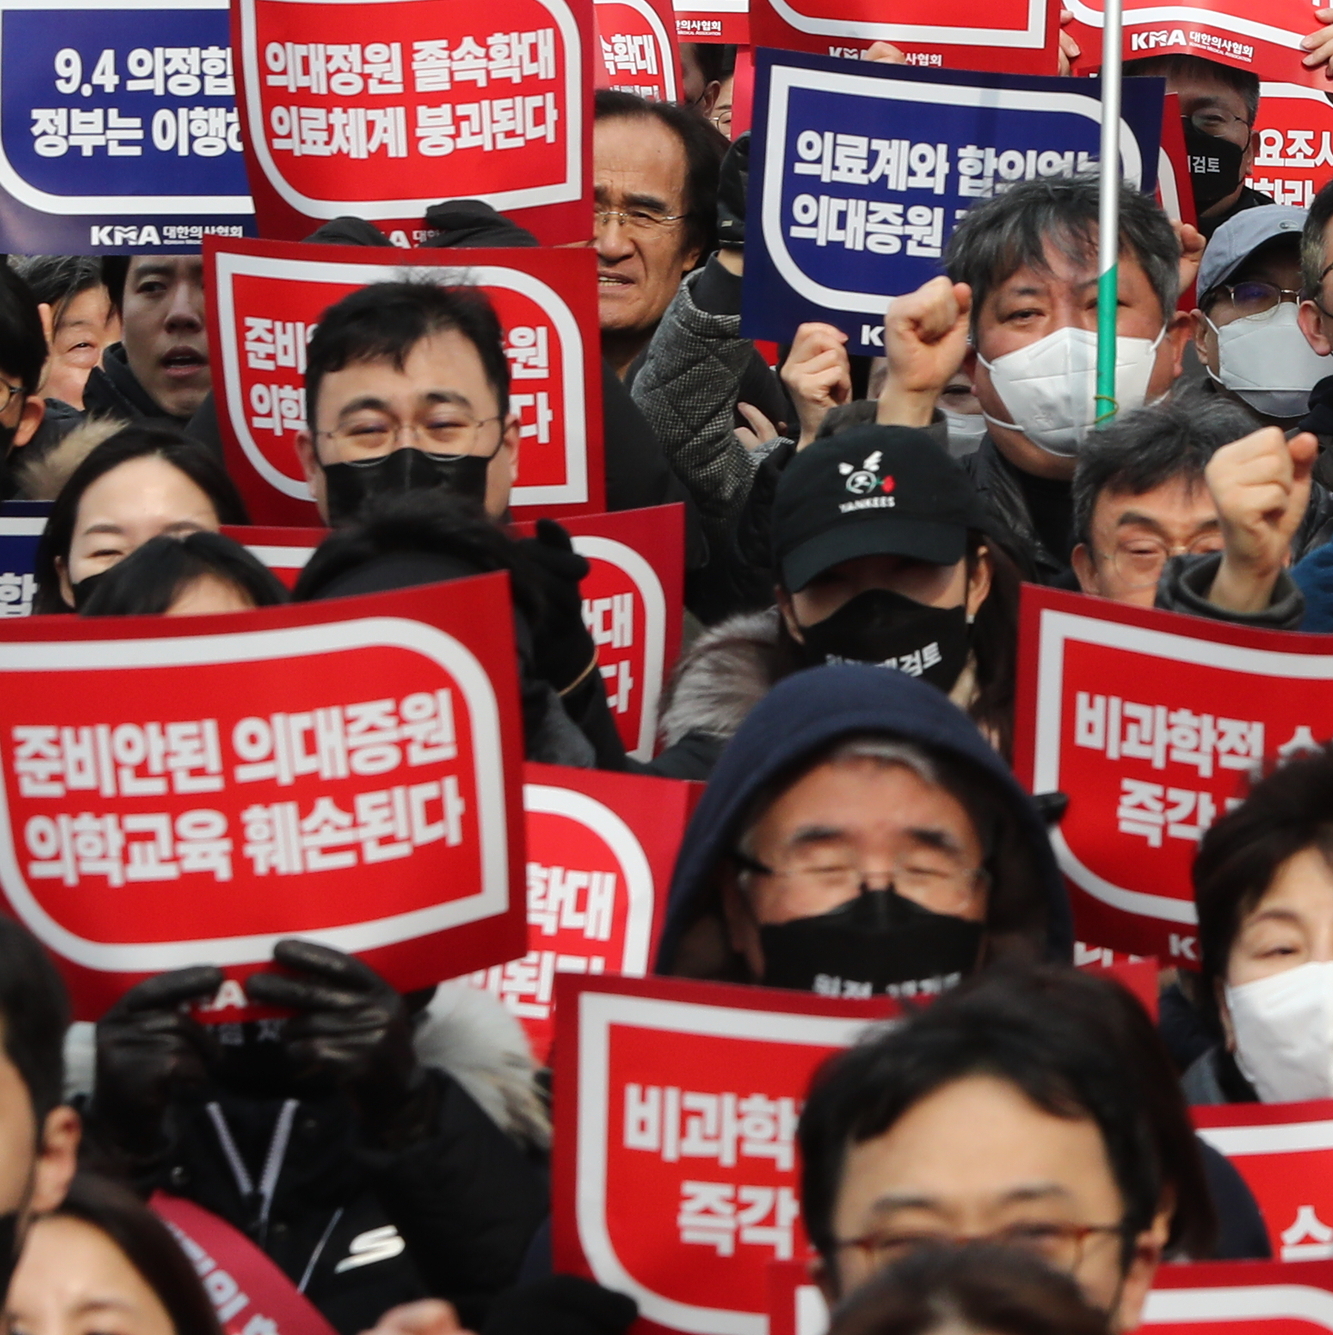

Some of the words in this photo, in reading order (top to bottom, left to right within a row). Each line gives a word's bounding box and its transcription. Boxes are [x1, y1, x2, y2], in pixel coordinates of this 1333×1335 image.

[54, 48, 120, 98] 9.4
[266, 40, 403, 96] 의대정원
[411, 27, 556, 90] 졸속확대
[1131, 30, 1186, 50] KMA
[1190, 31, 1253, 57] 대한의사협회
[30, 108, 144, 158] 정부는
[270, 106, 407, 158] 의료체계
[416, 92, 558, 158] 붕괴된다
[793, 129, 950, 195] 의료계와
[90, 224, 161, 247] KMA
[790, 192, 944, 258] 의대증원
[838, 496, 896, 513] YANKEES
[12, 716, 225, 799] 준비안된
[231, 687, 458, 788] 의대증원
[1073, 691, 1266, 778] 비과학적
[24, 808, 233, 887] 의학교육
[241, 775, 465, 877] 훼손된다
